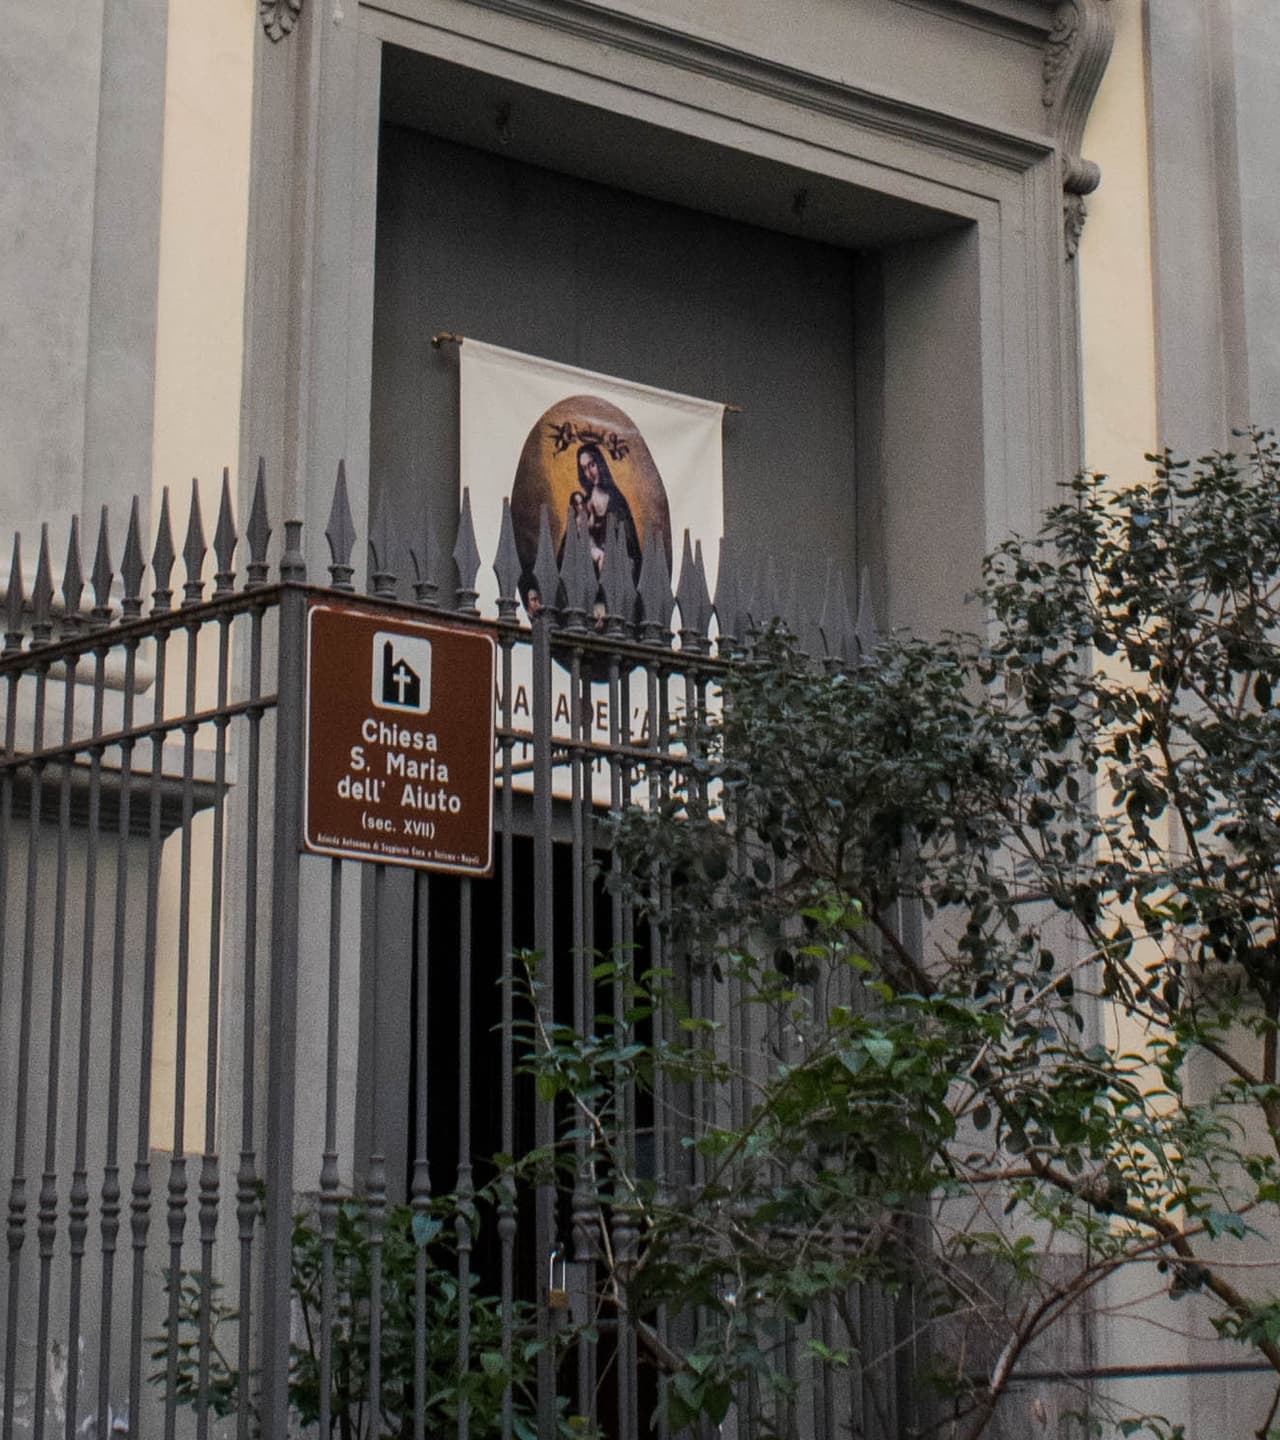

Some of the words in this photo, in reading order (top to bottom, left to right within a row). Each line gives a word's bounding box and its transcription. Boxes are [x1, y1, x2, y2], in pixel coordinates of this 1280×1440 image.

[361, 718, 438, 751] Chiesa
[350, 747, 371, 772] S.
[386, 752, 449, 783] Maria
[337, 775, 386, 804] dell'
[401, 784, 462, 814] Aiuto
[361, 811, 397, 833] (sec.
[403, 817, 436, 839] XVII)
